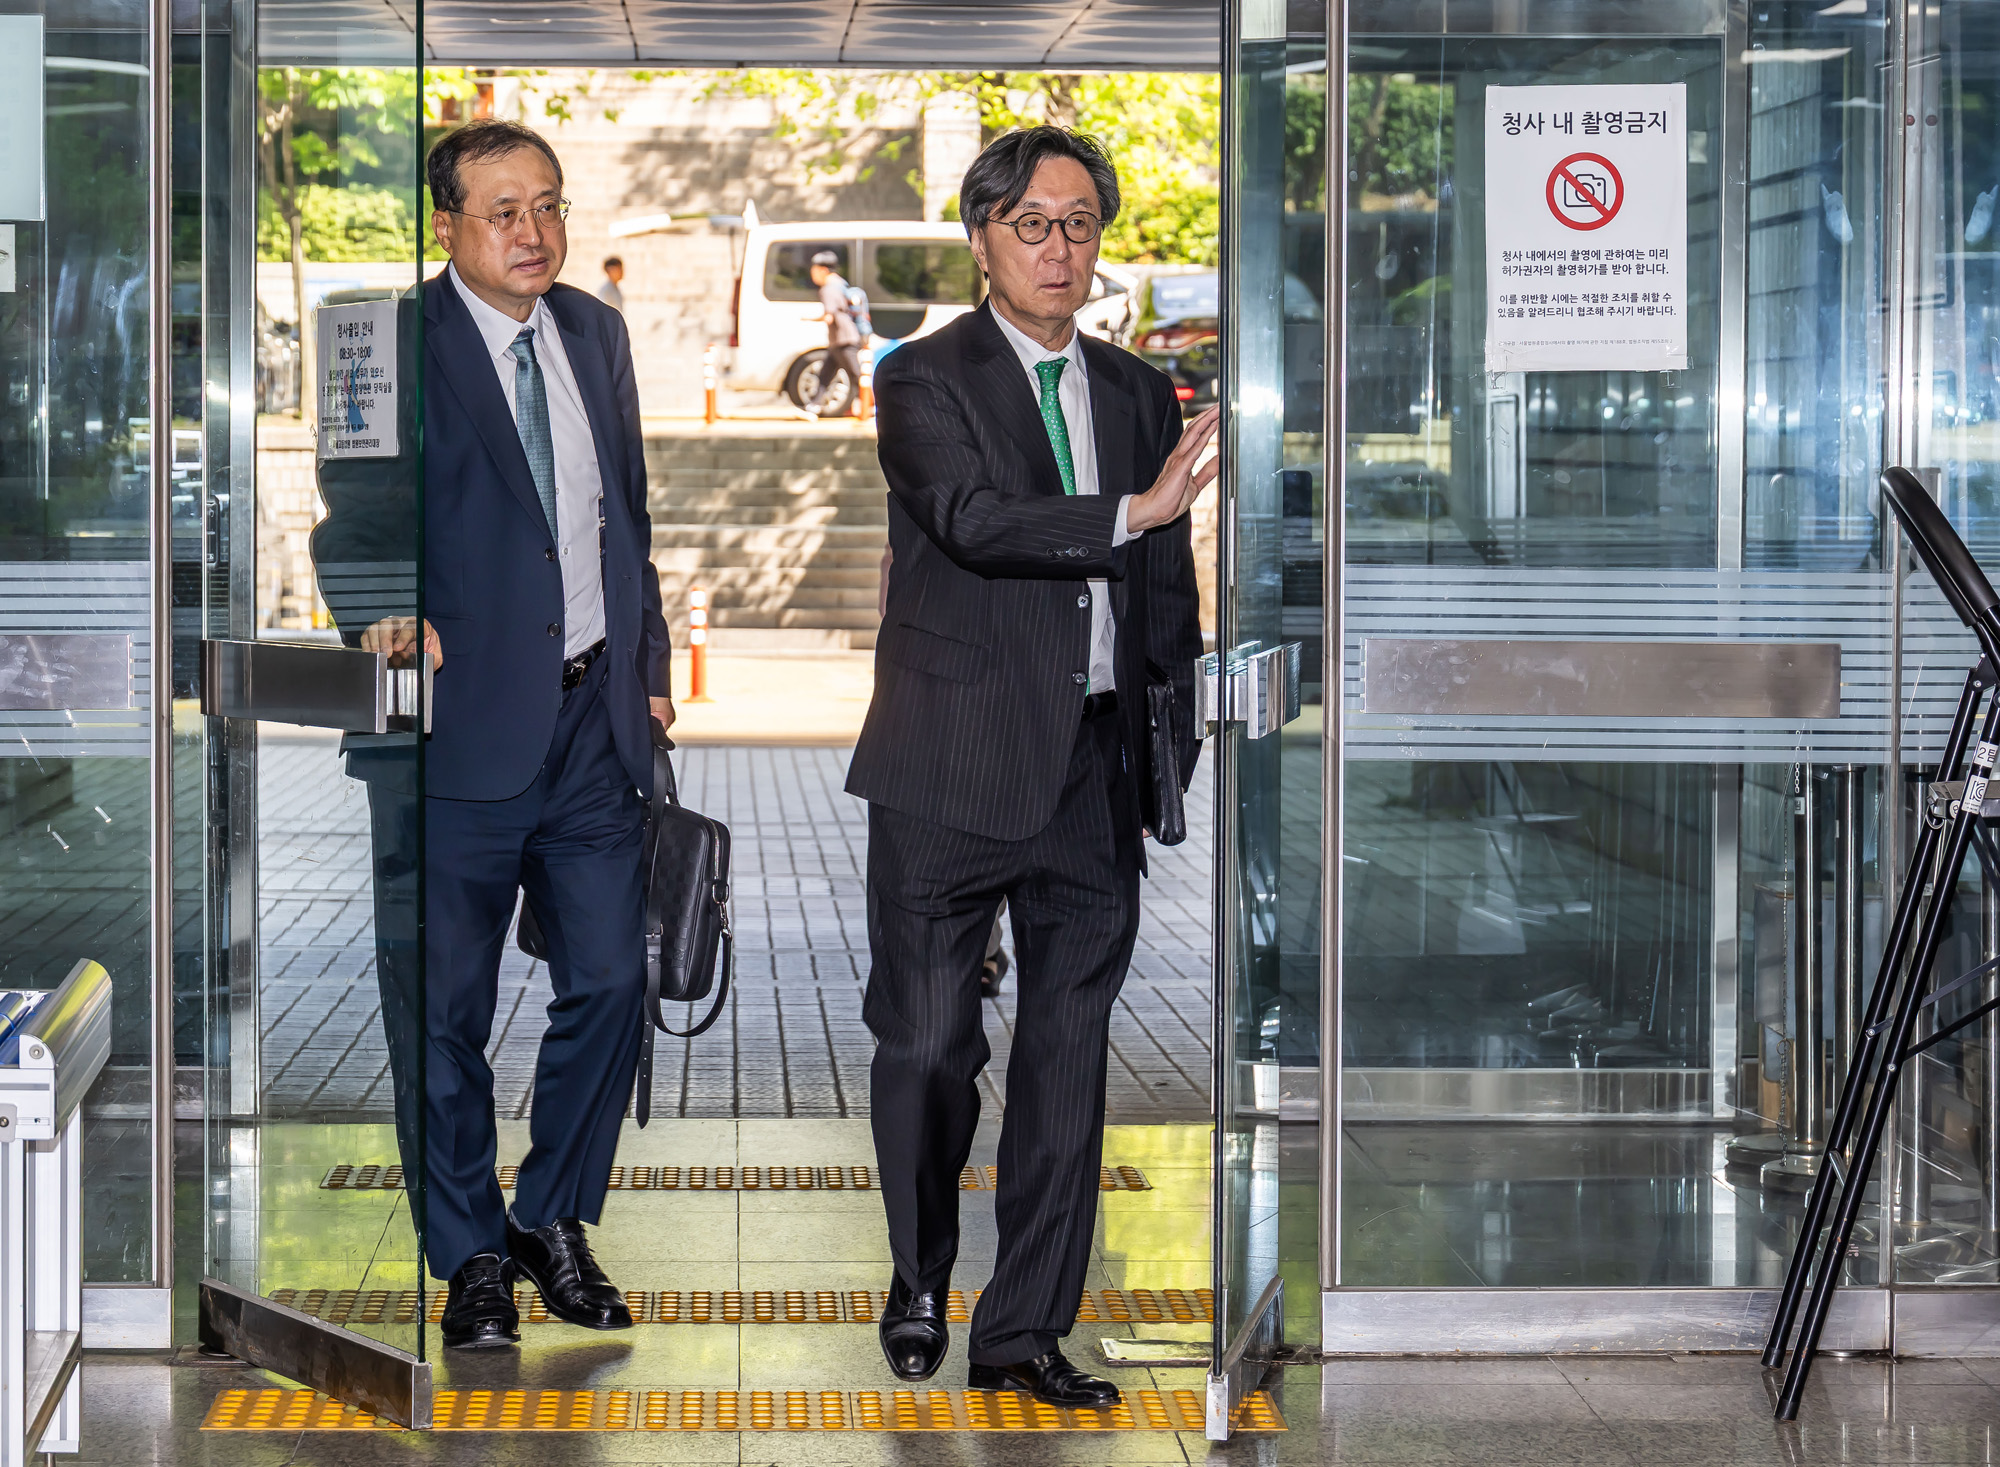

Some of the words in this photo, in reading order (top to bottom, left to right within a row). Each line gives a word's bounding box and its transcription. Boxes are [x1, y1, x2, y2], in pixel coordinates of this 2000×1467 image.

[1503, 112, 1545, 135] 청사
[1554, 112, 1572, 134] 내
[1581, 111, 1666, 134] 촬영금지
[1503, 251, 1522, 262] 청사
[1526, 250, 1566, 261] 내에서의
[1570, 250, 1600, 261] 촬영에
[1604, 249, 1645, 260] 관하여는
[1649, 249, 1668, 260] 미리
[1502, 265, 1552, 276] 허가권자의
[1557, 264, 1608, 276] 촬영허가를
[1612, 264, 1632, 275] 받아
[1635, 263, 1668, 274] 합니다.
[1500, 295, 1517, 304] 이를
[1521, 294, 1548, 304] 위반할
[1551, 294, 1578, 303] 시에는
[1582, 293, 1608, 303] 적절한
[1612, 293, 1638, 302] 조치를
[1642, 293, 1659, 302] 취할
[1663, 293, 1671, 302] 수
[1498, 308, 1524, 317] 있음을
[1528, 307, 1573, 317] 알려드리니
[1577, 307, 1603, 316] 협조해
[1607, 306, 1633, 316] 주시기
[1638, 306, 1676, 315] 바랍니다.
[337, 321, 359, 338] 청사출입
[361, 320, 373, 336] 안내
